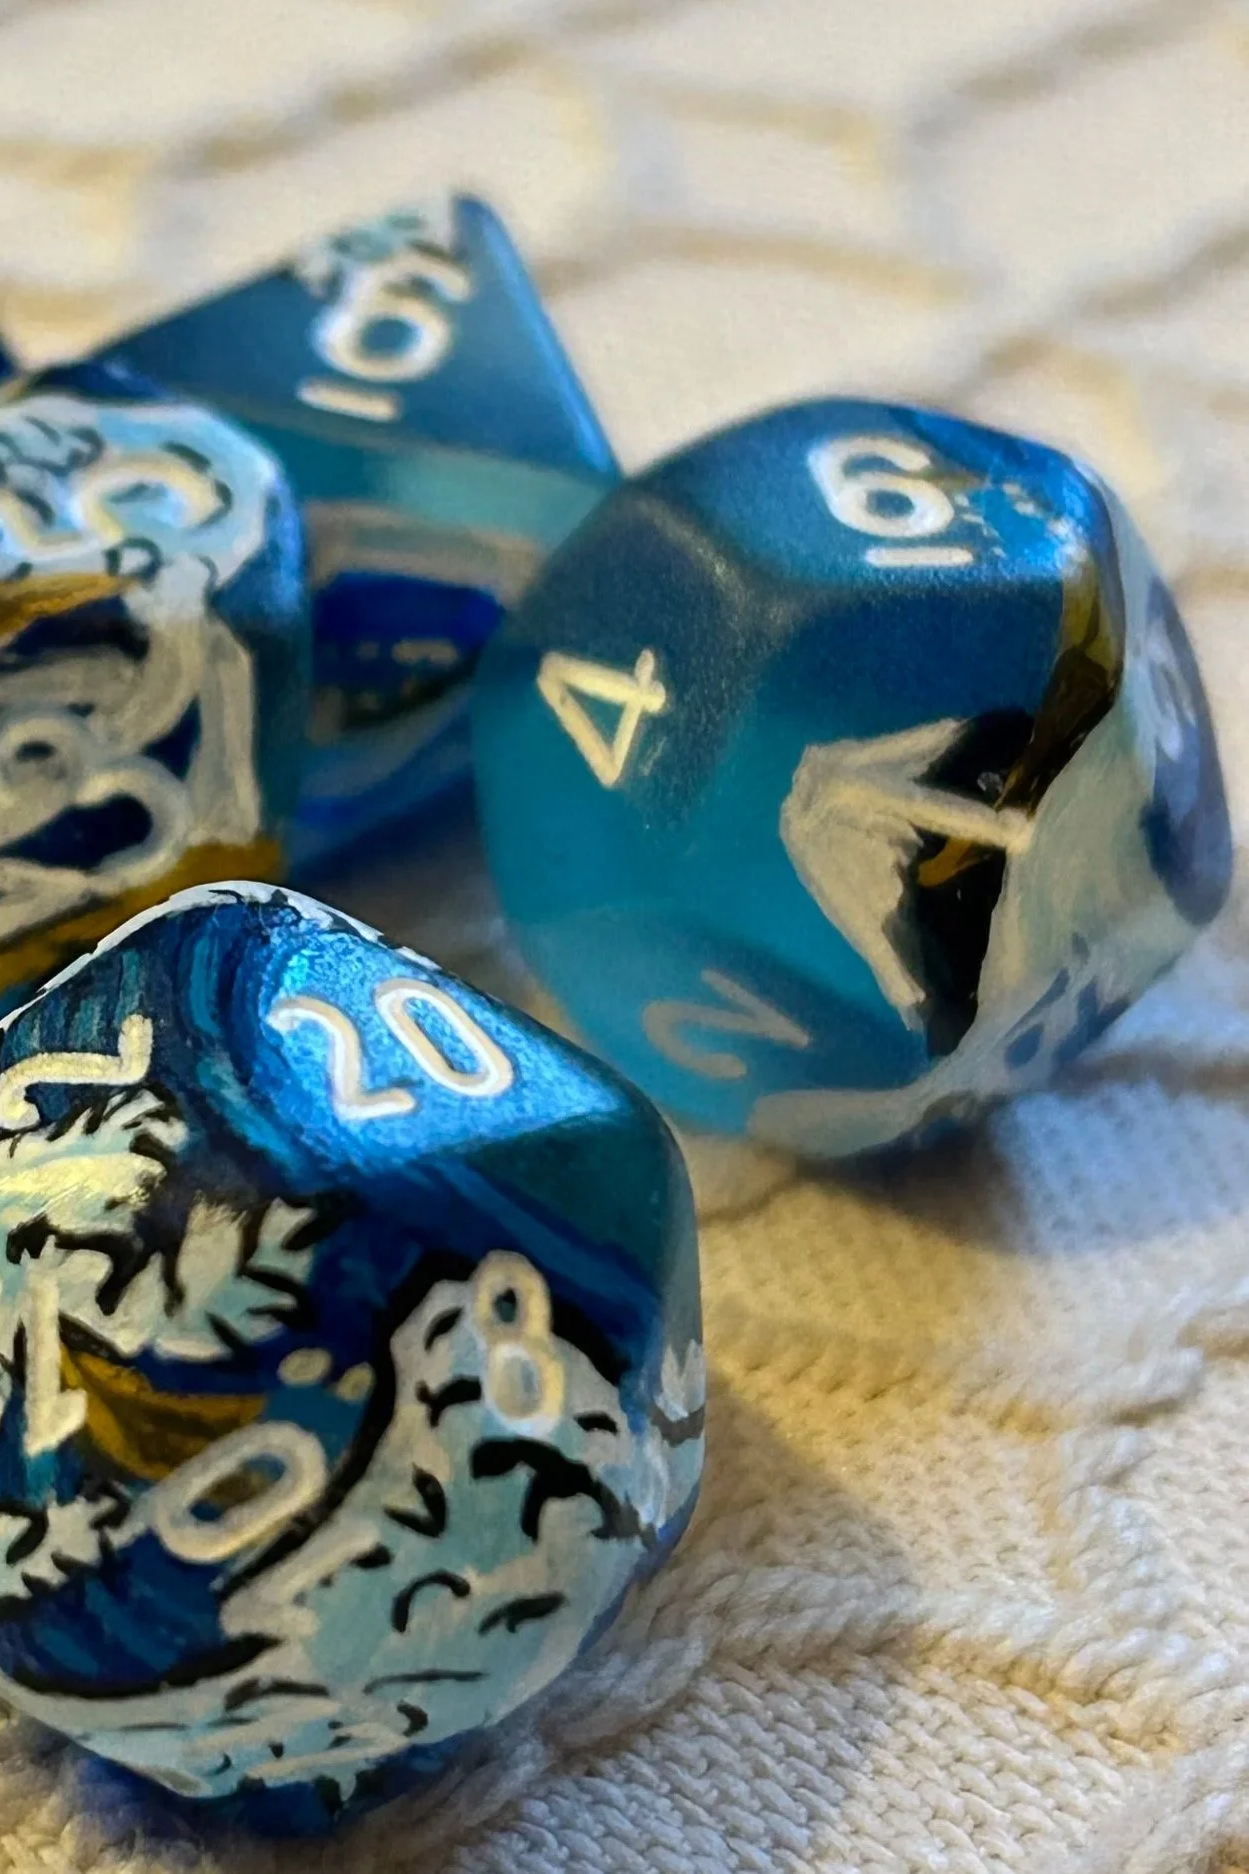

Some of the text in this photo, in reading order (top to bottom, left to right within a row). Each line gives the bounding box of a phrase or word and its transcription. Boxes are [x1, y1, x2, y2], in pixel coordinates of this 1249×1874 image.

[295, 250, 473, 424] 6
[807, 433, 976, 568] 6
[536, 646, 668, 791] 4
[265, 976, 517, 1122] 20
[638, 966, 814, 1081] 2
[472, 1248, 566, 1438] 8
